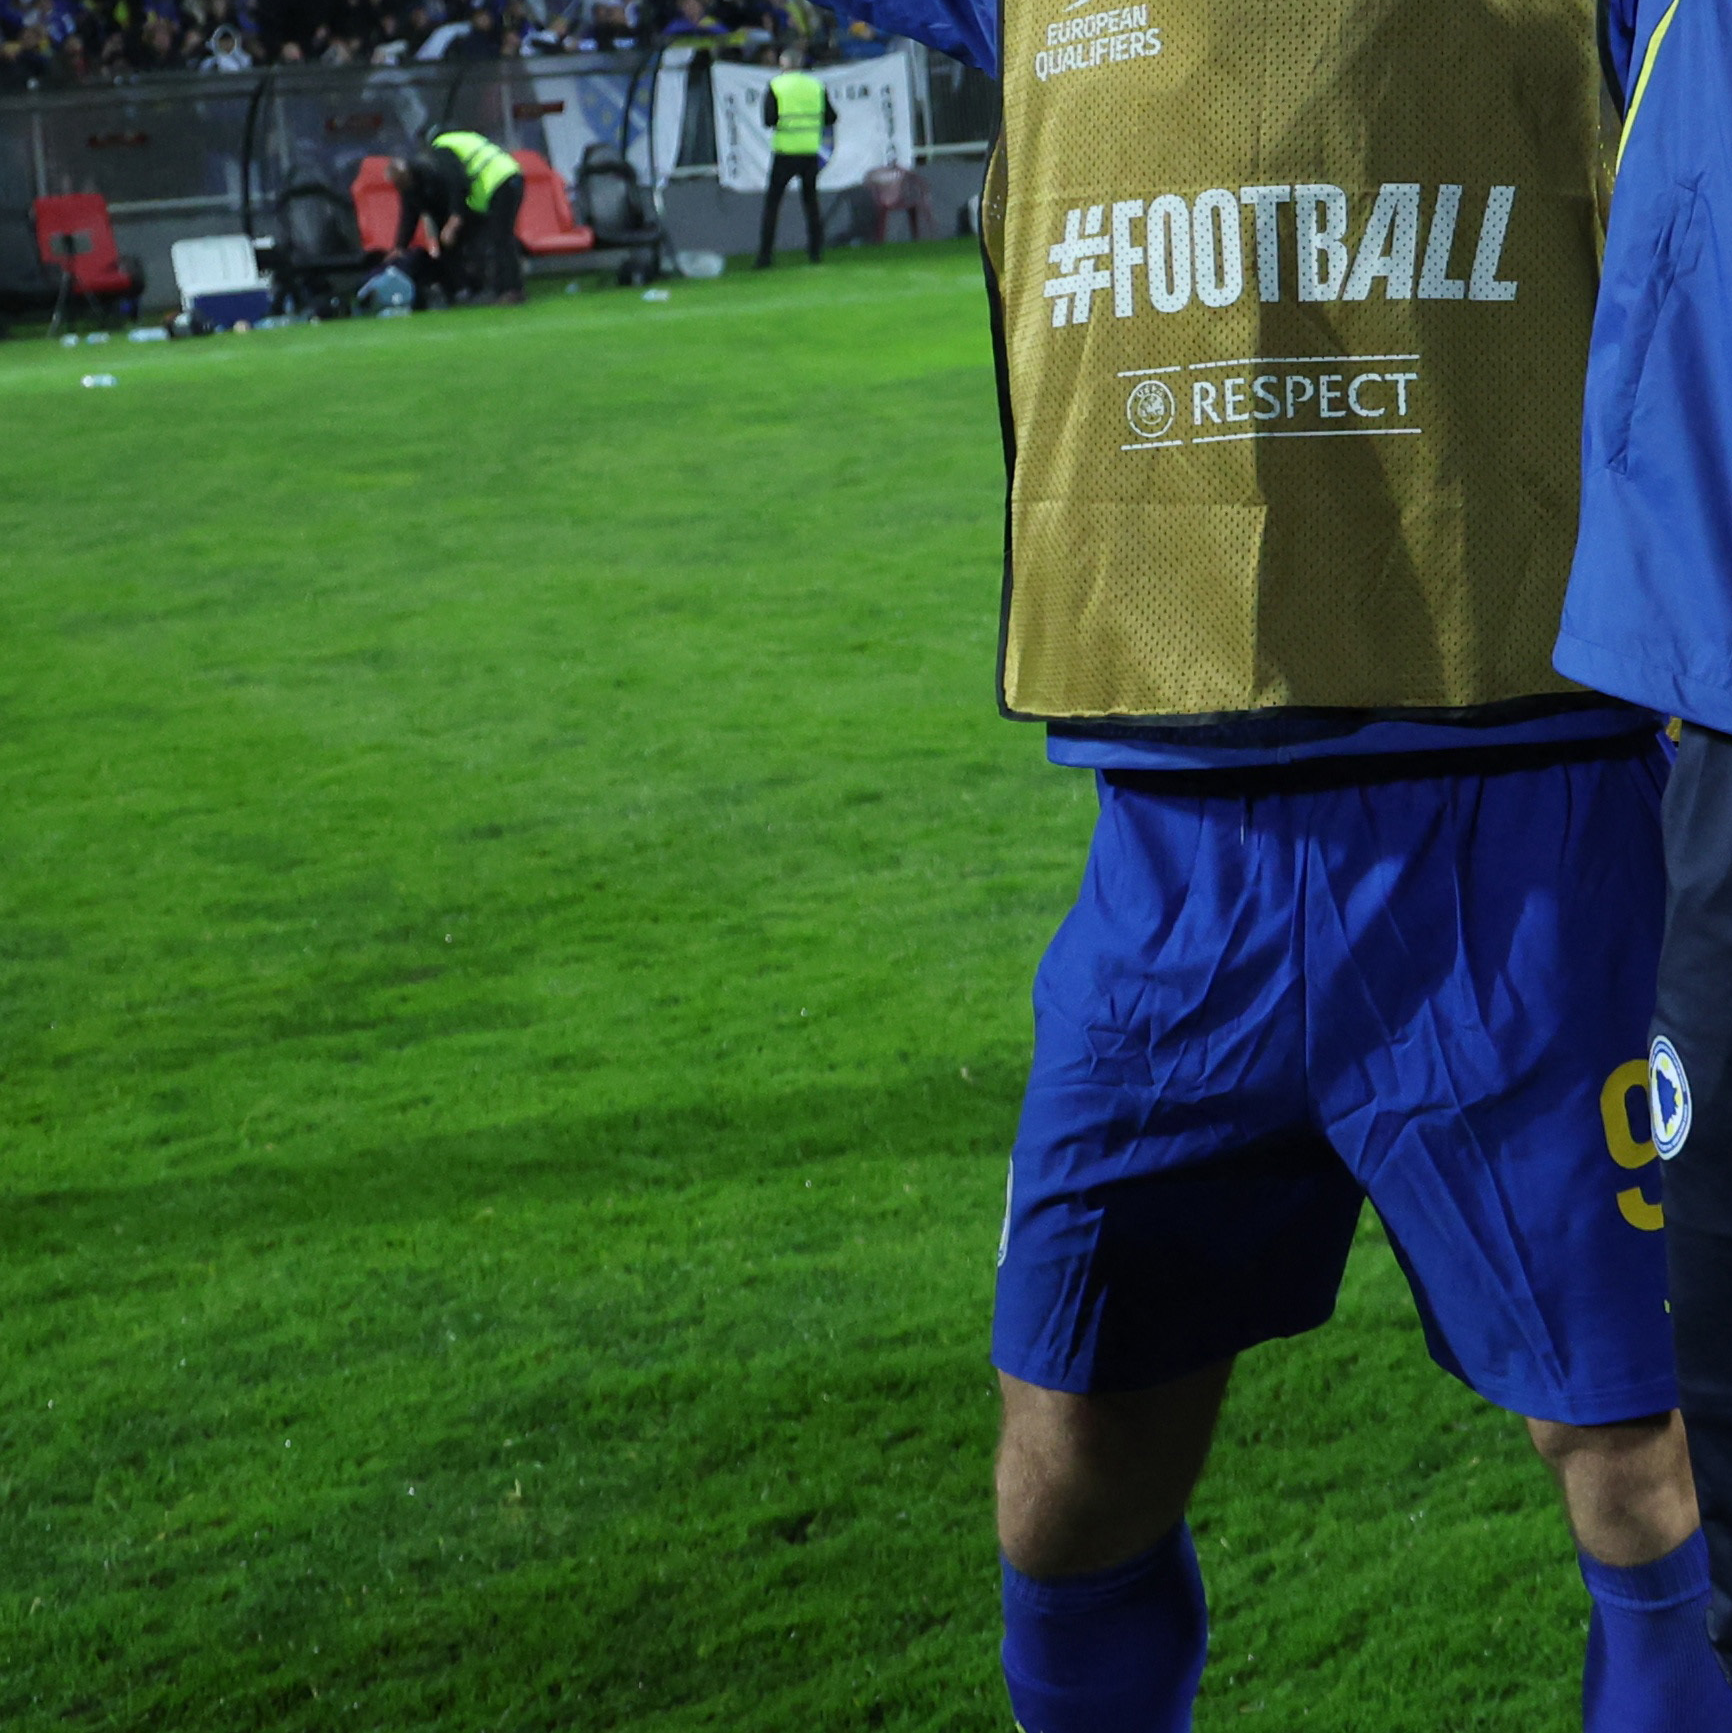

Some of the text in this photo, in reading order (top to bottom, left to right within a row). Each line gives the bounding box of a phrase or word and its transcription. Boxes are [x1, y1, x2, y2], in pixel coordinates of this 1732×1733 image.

[1046, 3, 1148, 46] EUROPEAN
[1035, 28, 1162, 81] QUALIFIERS
[1043, 182, 1518, 328] #FOOTBALL
[1191, 372, 1418, 426] RESPECT
